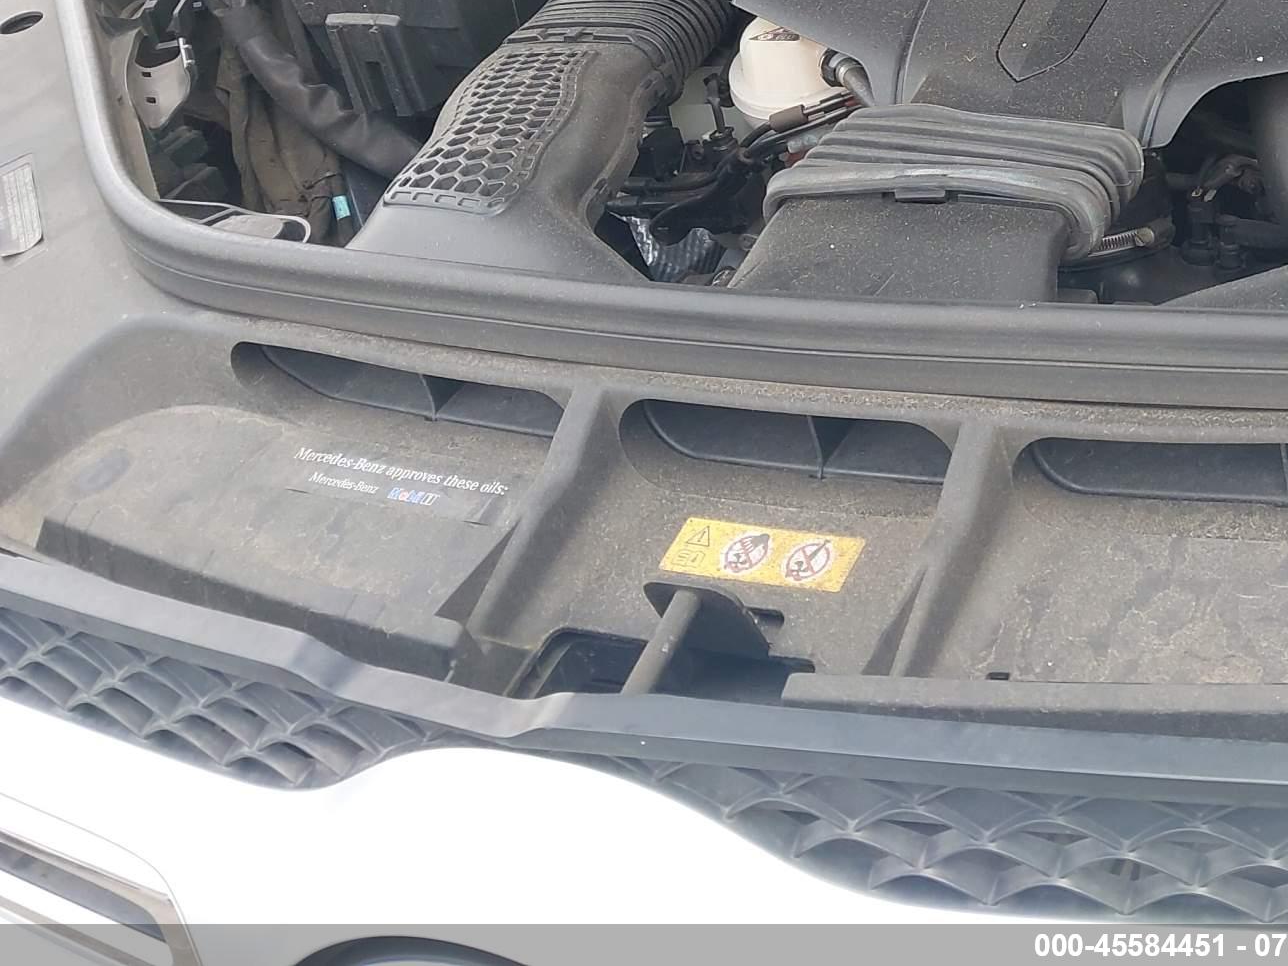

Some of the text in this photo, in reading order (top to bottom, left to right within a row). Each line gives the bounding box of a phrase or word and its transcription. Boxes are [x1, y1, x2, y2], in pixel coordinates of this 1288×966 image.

[294, 447, 509, 496] Mercedes-Benz approves these oils:
[308, 471, 379, 495] Mercedes-Benz
